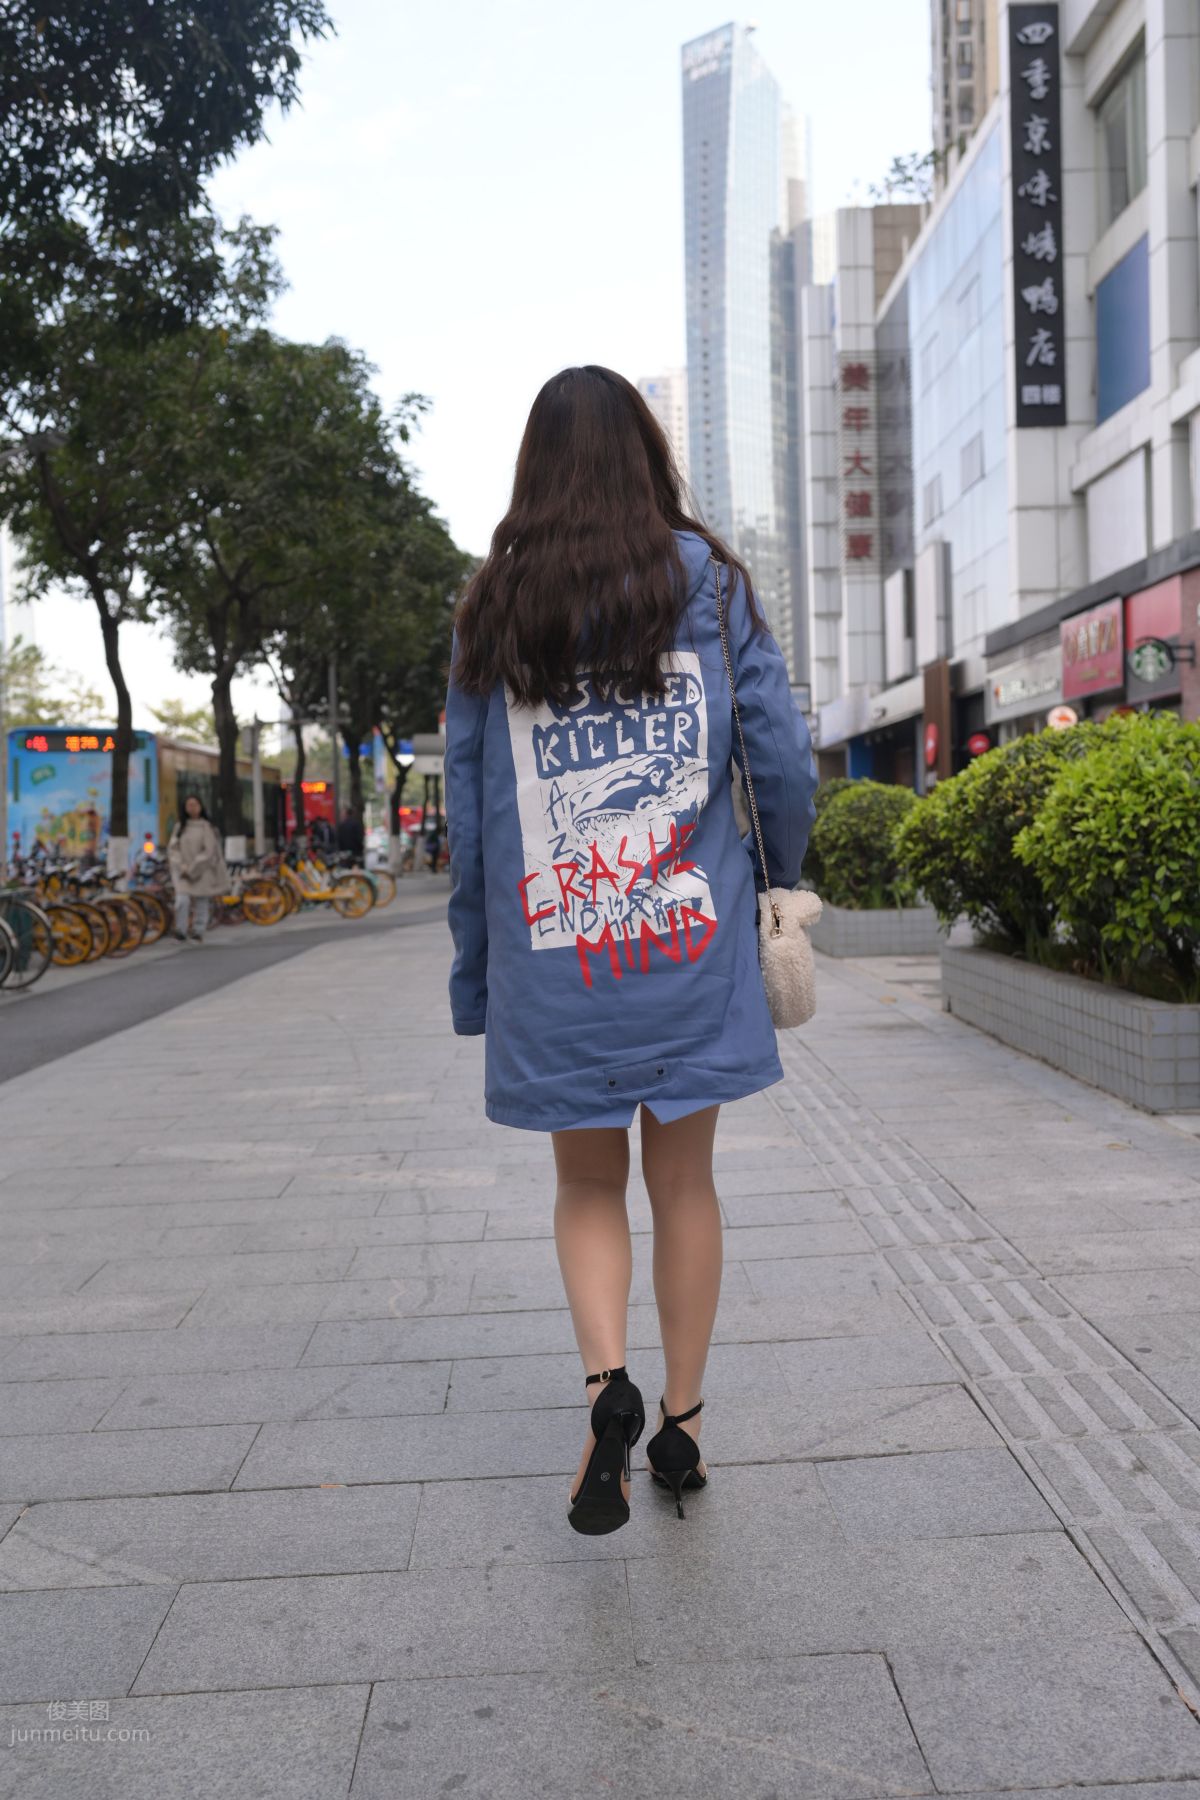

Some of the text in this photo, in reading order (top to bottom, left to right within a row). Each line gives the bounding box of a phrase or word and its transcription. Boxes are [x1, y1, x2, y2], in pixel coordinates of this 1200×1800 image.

[555, 675, 702, 713] SYCHED
[538, 711, 693, 771] KILLER
[576, 905, 718, 989] MIND
